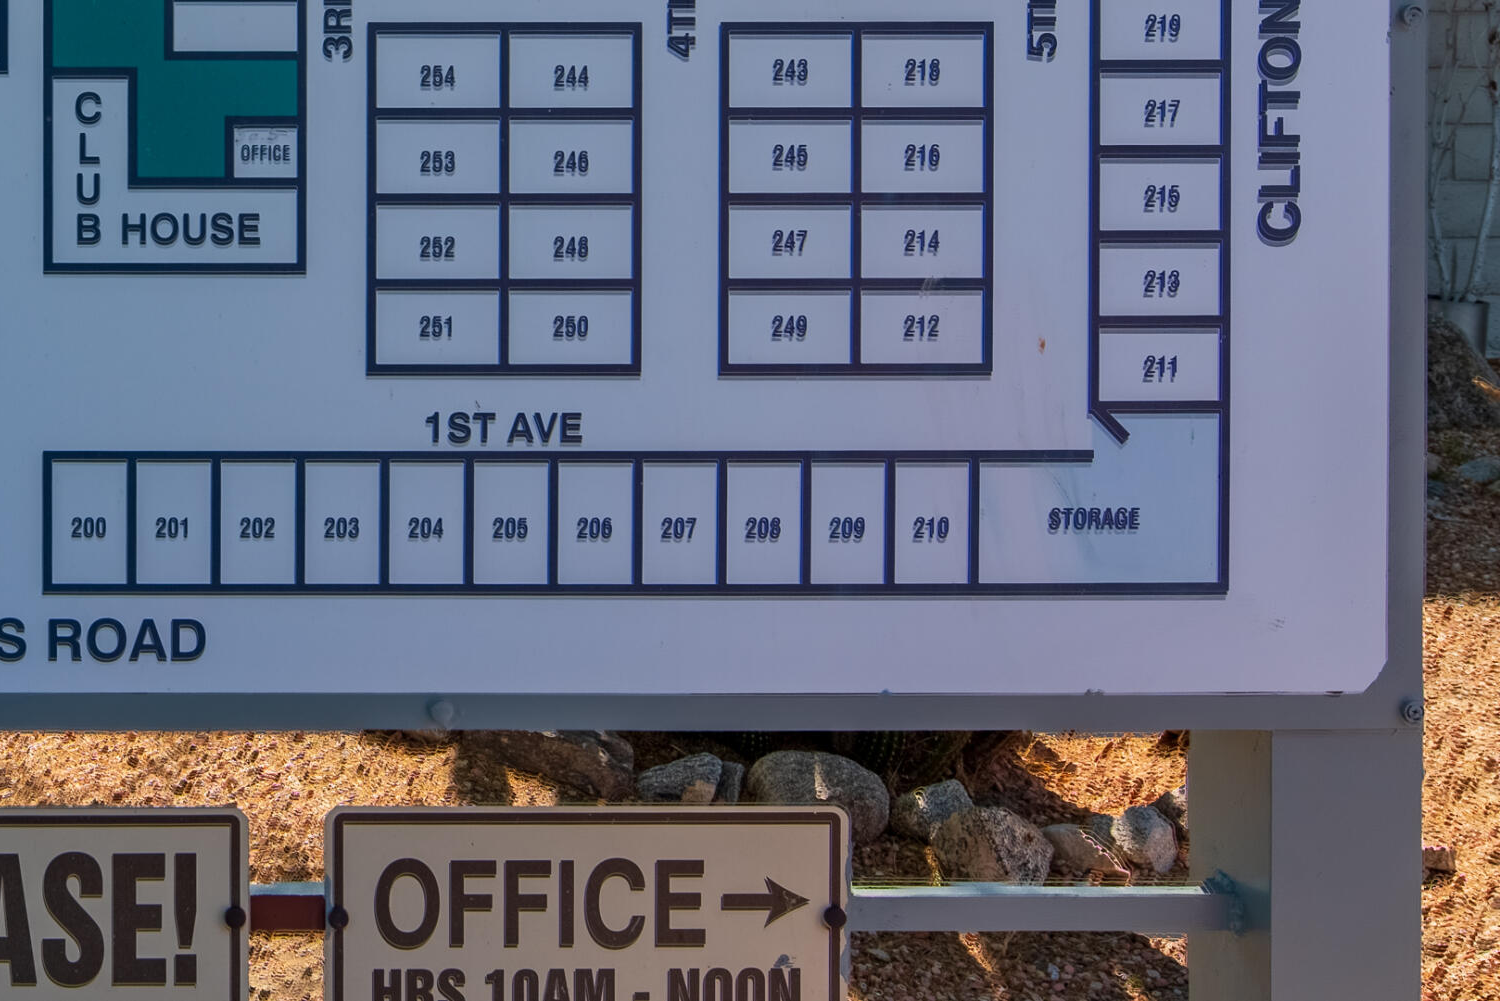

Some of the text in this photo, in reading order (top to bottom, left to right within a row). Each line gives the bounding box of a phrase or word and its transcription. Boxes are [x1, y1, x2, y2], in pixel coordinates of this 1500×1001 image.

[420, 64, 456, 88] 254
[553, 64, 589, 91] 244
[772, 58, 809, 86] 243
[904, 58, 941, 87] 218
[1144, 99, 1181, 128] 217
[240, 143, 291, 162] OFFICE
[419, 150, 456, 173] 253
[553, 150, 589, 176] 246
[772, 144, 808, 171] 245
[904, 143, 941, 172] 216
[1143, 184, 1181, 213] 215
[121, 212, 261, 247] HOUSE
[772, 229, 808, 256] 247
[904, 229, 940, 257] 214
[419, 235, 455, 259] 252
[553, 235, 589, 262] 248
[1143, 269, 1181, 298] 213
[419, 315, 453, 338] 251
[553, 315, 589, 338] 250
[771, 314, 808, 342] 249
[903, 314, 940, 341] 212
[1142, 355, 1178, 383] 211
[425, 411, 583, 445] 1ST AVE
[71, 516, 107, 539] 200
[155, 516, 189, 539] 201
[239, 516, 276, 539] 202
[323, 517, 360, 539] 203
[408, 516, 444, 540] 204
[492, 516, 529, 540] 205
[576, 516, 613, 540] 206
[660, 516, 697, 543] 207
[745, 516, 782, 543] 208
[829, 516, 866, 543] 209
[913, 516, 950, 543] 210
[1048, 506, 1141, 531] STORAGE
[47, 617, 207, 663] ROAD
[373, 857, 707, 950] OFFICE
